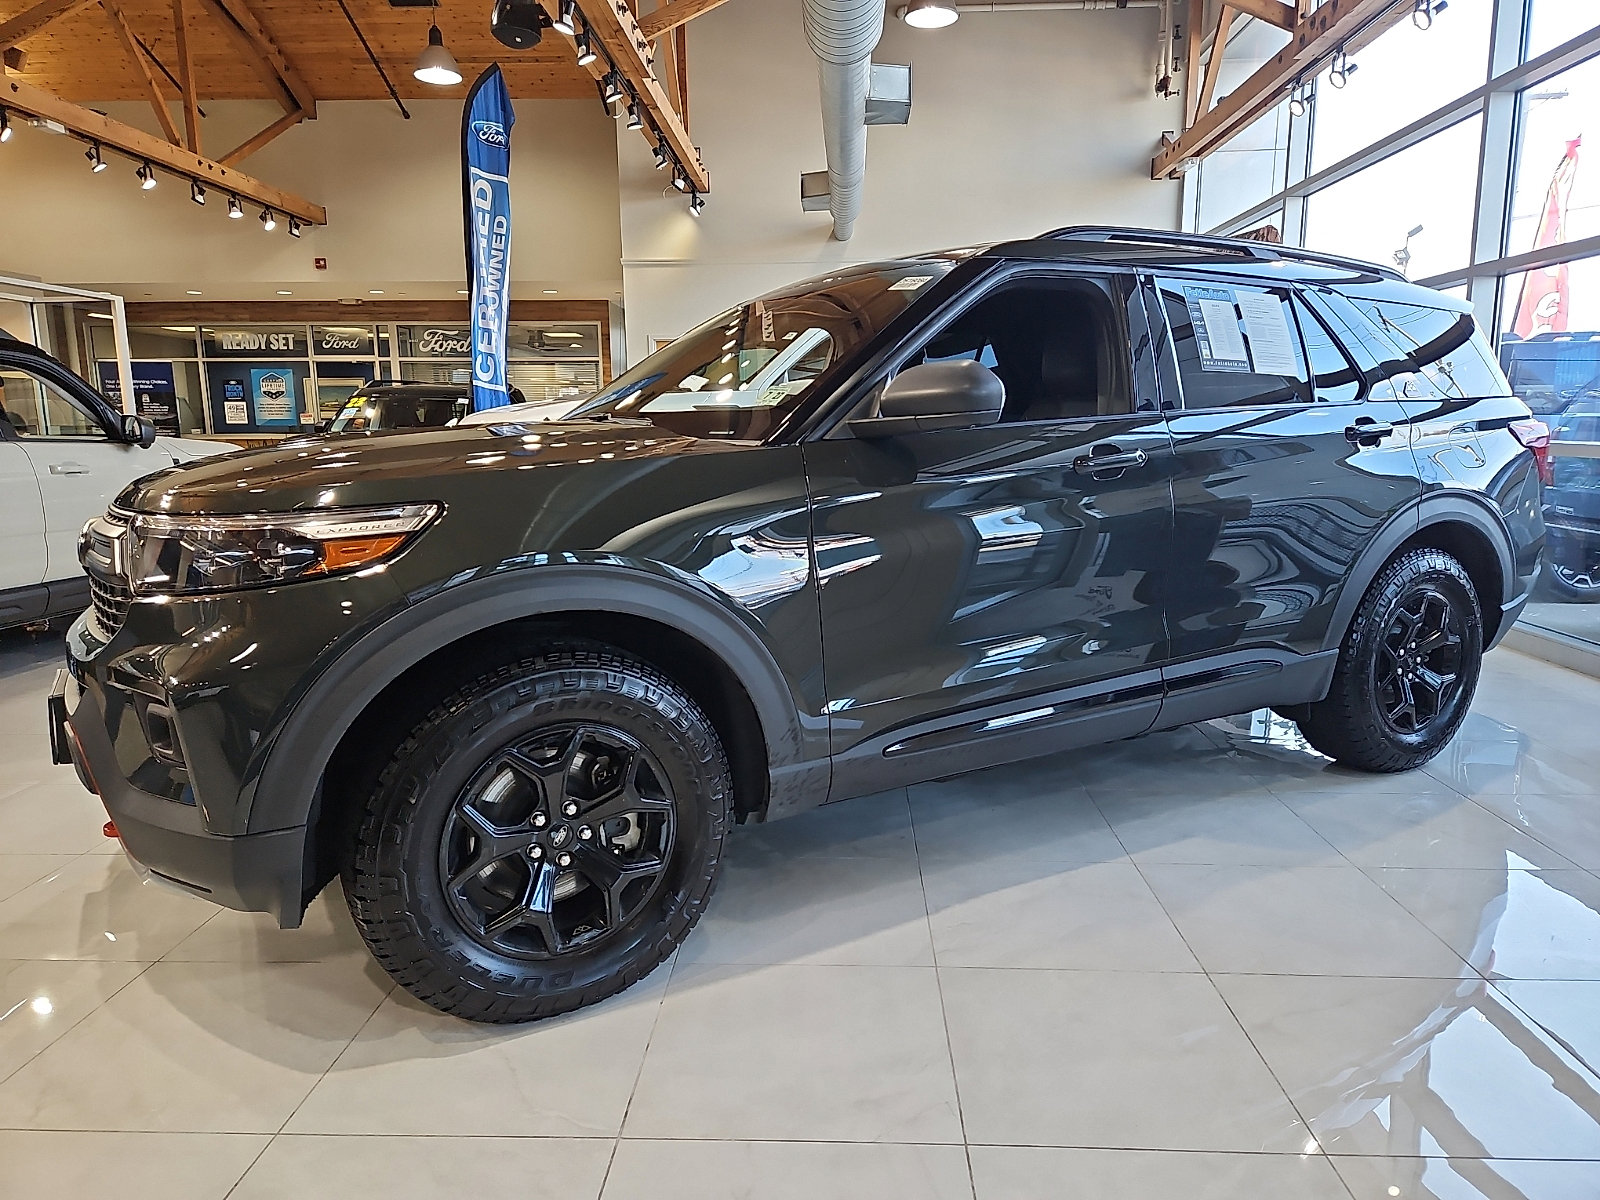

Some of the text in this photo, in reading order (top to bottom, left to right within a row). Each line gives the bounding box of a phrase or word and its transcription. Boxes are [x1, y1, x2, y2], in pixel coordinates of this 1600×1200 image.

[479, 124, 505, 145] For
[222, 333, 295, 350] READY SET
[322, 332, 360, 349] Ford
[419, 329, 471, 352] Ford
[316, 521, 405, 534] EXPLORER
